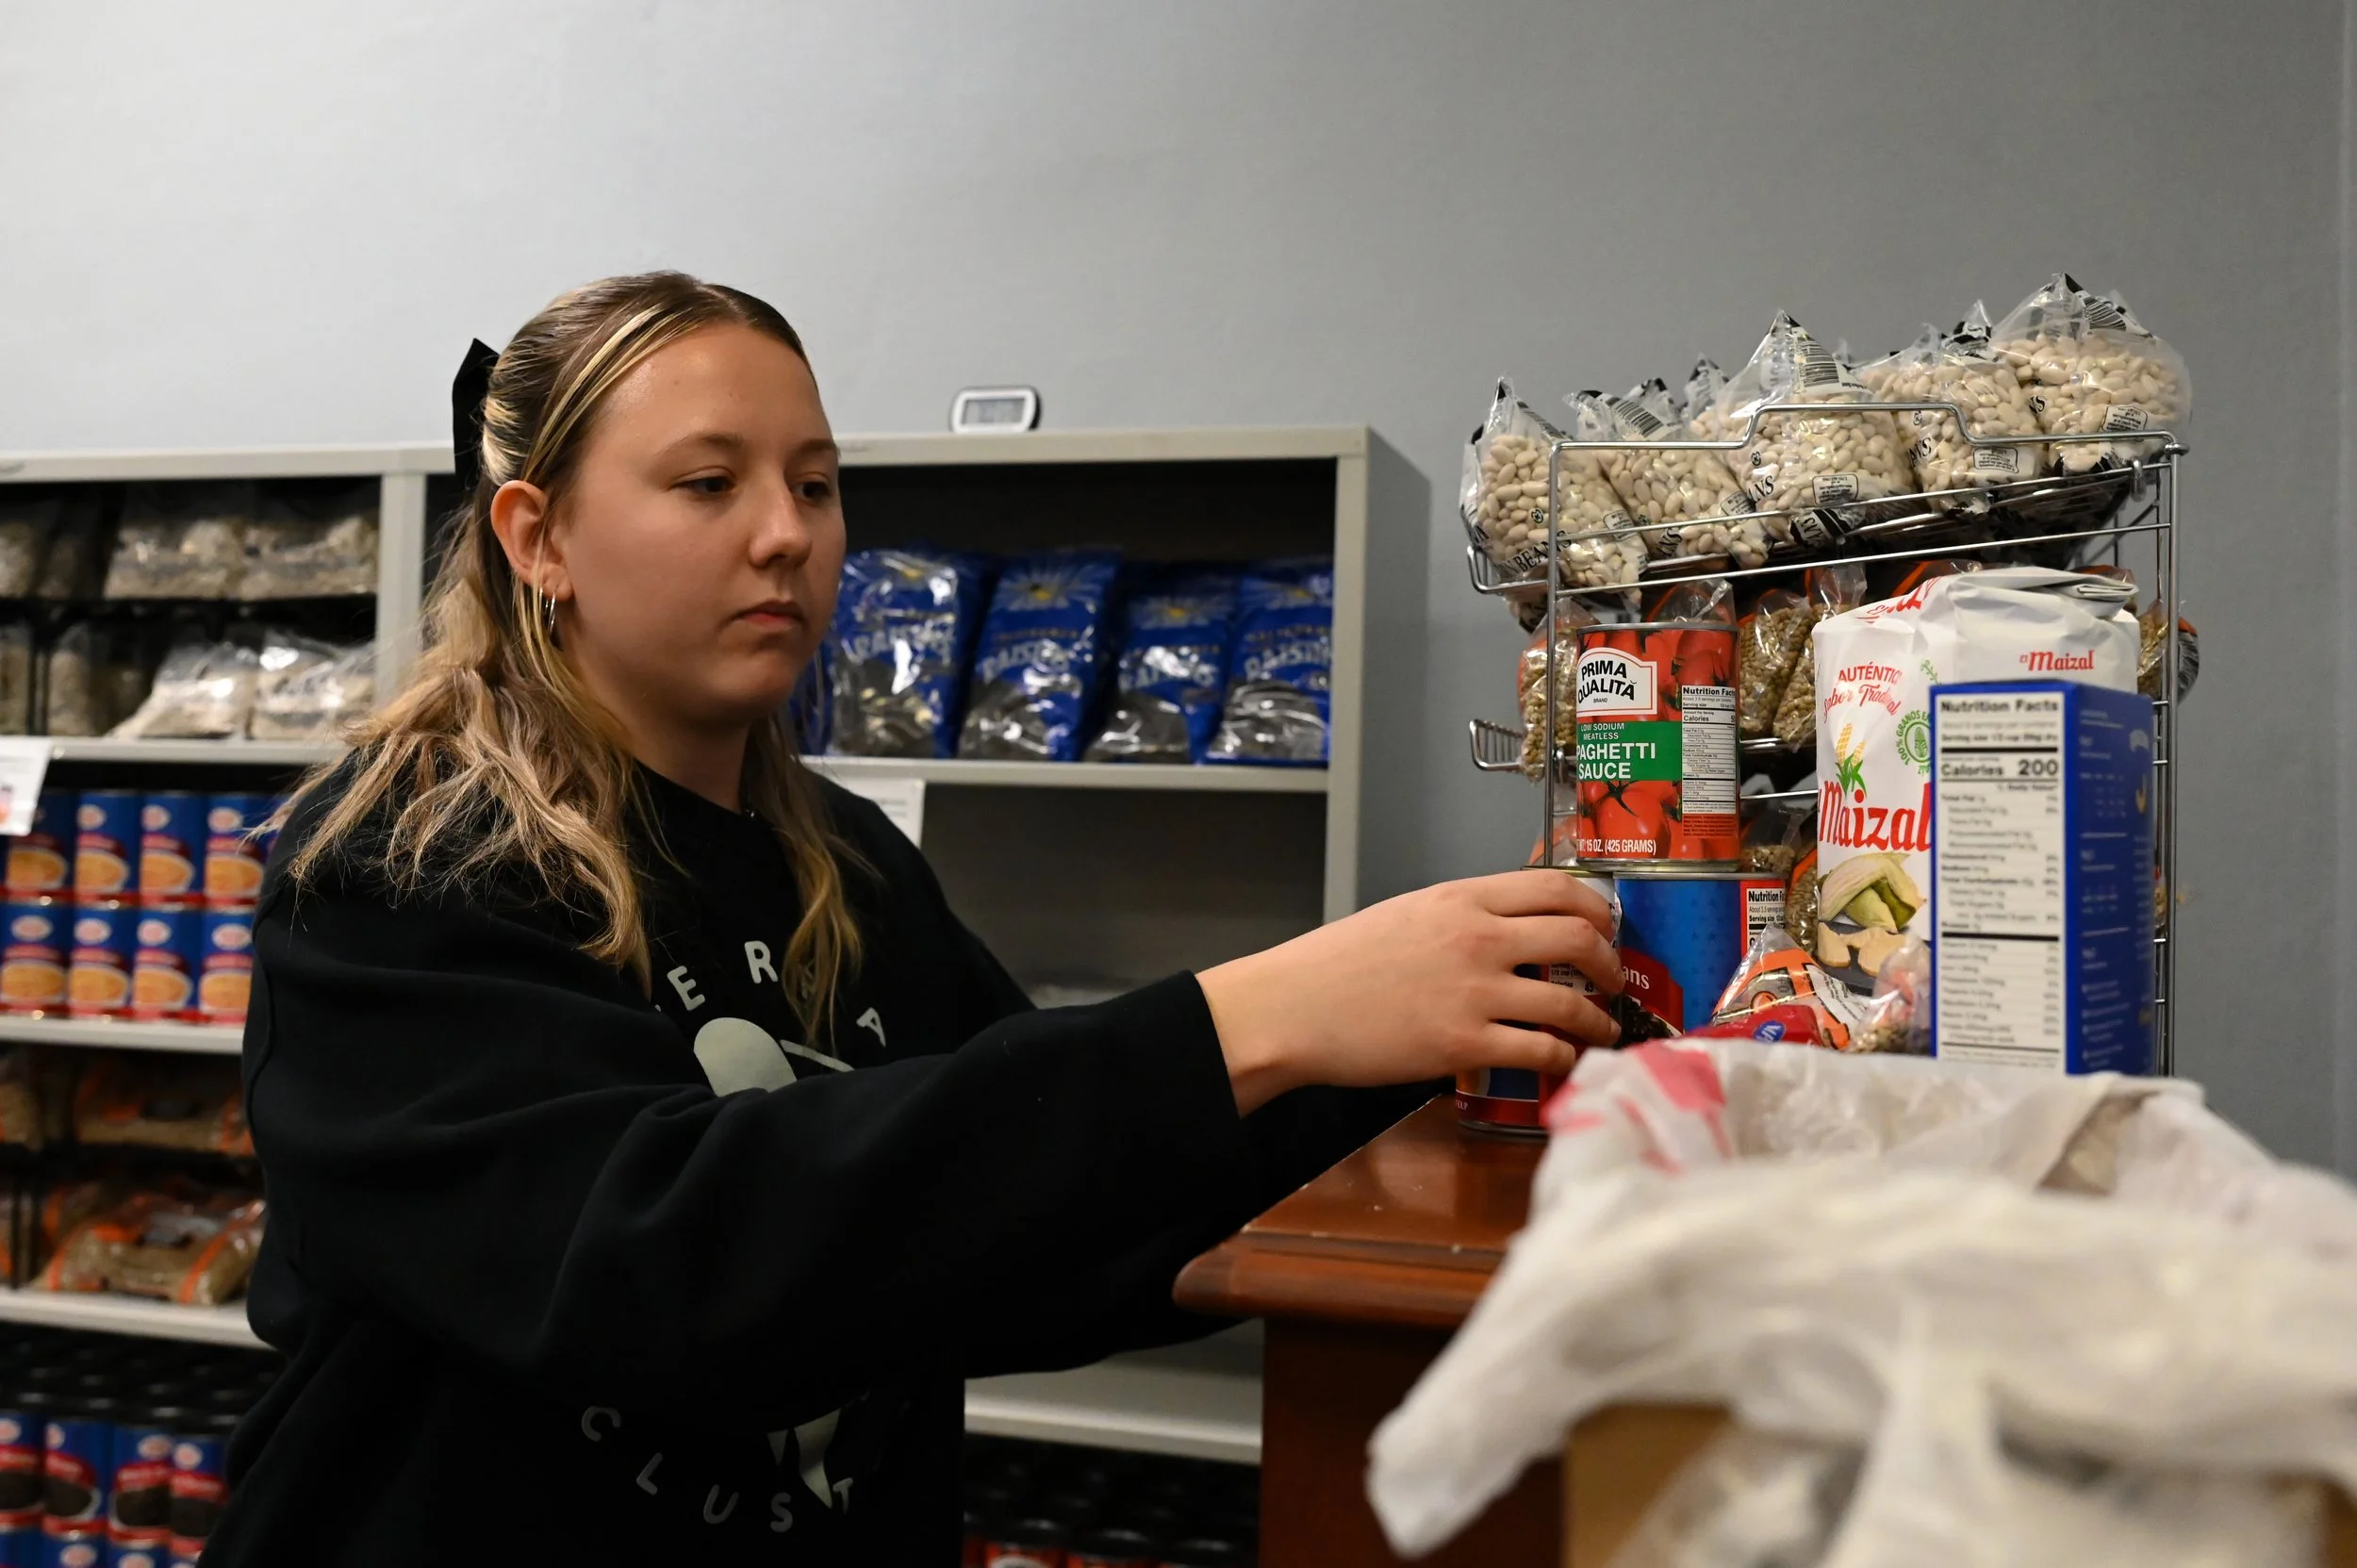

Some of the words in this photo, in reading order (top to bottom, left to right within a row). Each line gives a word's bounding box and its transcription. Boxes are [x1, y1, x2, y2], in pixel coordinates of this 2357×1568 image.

[1513, 530, 1572, 572] BEAS
[2028, 649, 2095, 671] Maizal
[1581, 660, 1627, 681] PRIMA
[1941, 701, 2010, 712] Nutrition
[2016, 699, 2058, 711] Facts
[1581, 723, 1591, 732] LOW
[1593, 722, 1624, 731] SODIUM
[1583, 732, 1619, 740] MEATLESS
[1576, 742, 1656, 761] PAGHETTI
[1578, 762, 1631, 780] SAUCE
[1942, 763, 2003, 776] Calories
[2019, 759, 2058, 776] 200
[1819, 780, 1932, 852] Maizal
[1605, 838, 1620, 855] (425
[1622, 838, 1656, 855] GRAMS)
[1749, 891, 1778, 901] Nutrition
